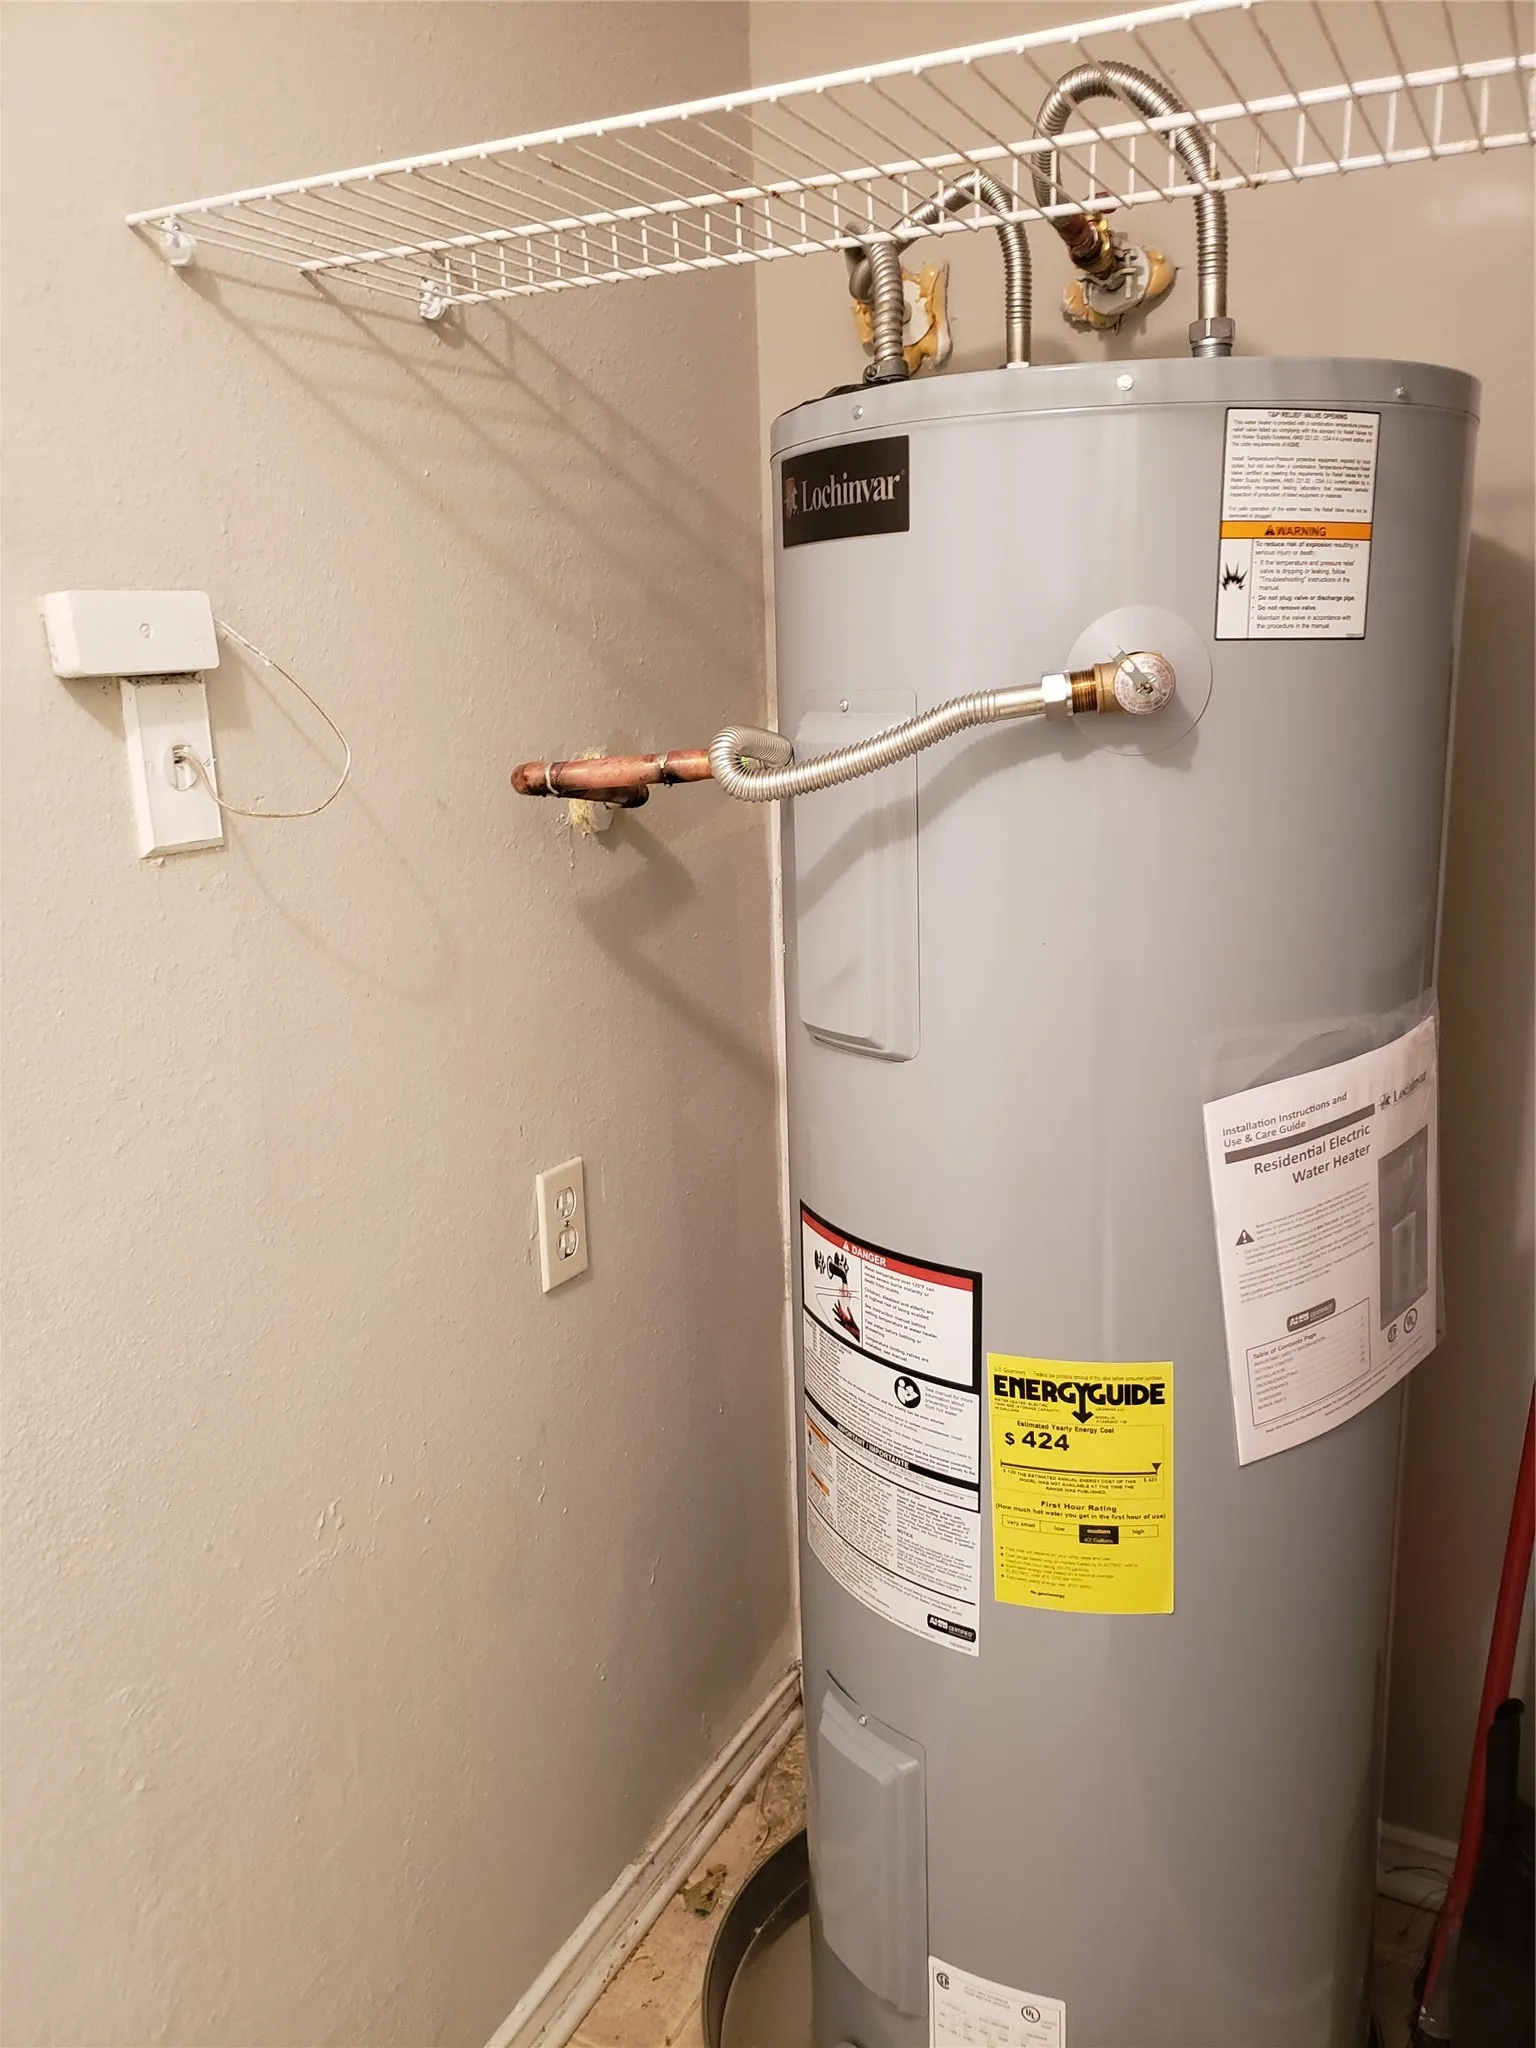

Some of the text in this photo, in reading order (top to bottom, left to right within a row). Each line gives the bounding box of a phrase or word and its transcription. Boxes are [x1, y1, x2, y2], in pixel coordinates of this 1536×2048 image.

[802, 472, 900, 512] Lochinvar
[1277, 526, 1326, 536] WARNING
[1223, 1092, 1348, 1136] Installation Instructions and
[1224, 1119, 1306, 1148] Use & Care Guide
[1254, 1124, 1370, 1175] Residential Electric
[1292, 1144, 1370, 1184] Water Heater
[852, 1246, 886, 1267] DANGER
[994, 1374, 1165, 1407] ENERGYGUIDE
[1005, 1431, 1070, 1451] $ 424
[1017, 1421, 1048, 1430] Estimated
[837, 1424, 865, 1448] IMPORTANT
[869, 1444, 910, 1469] IMPORTANTE
[1088, 1505, 1117, 1513] Rating
